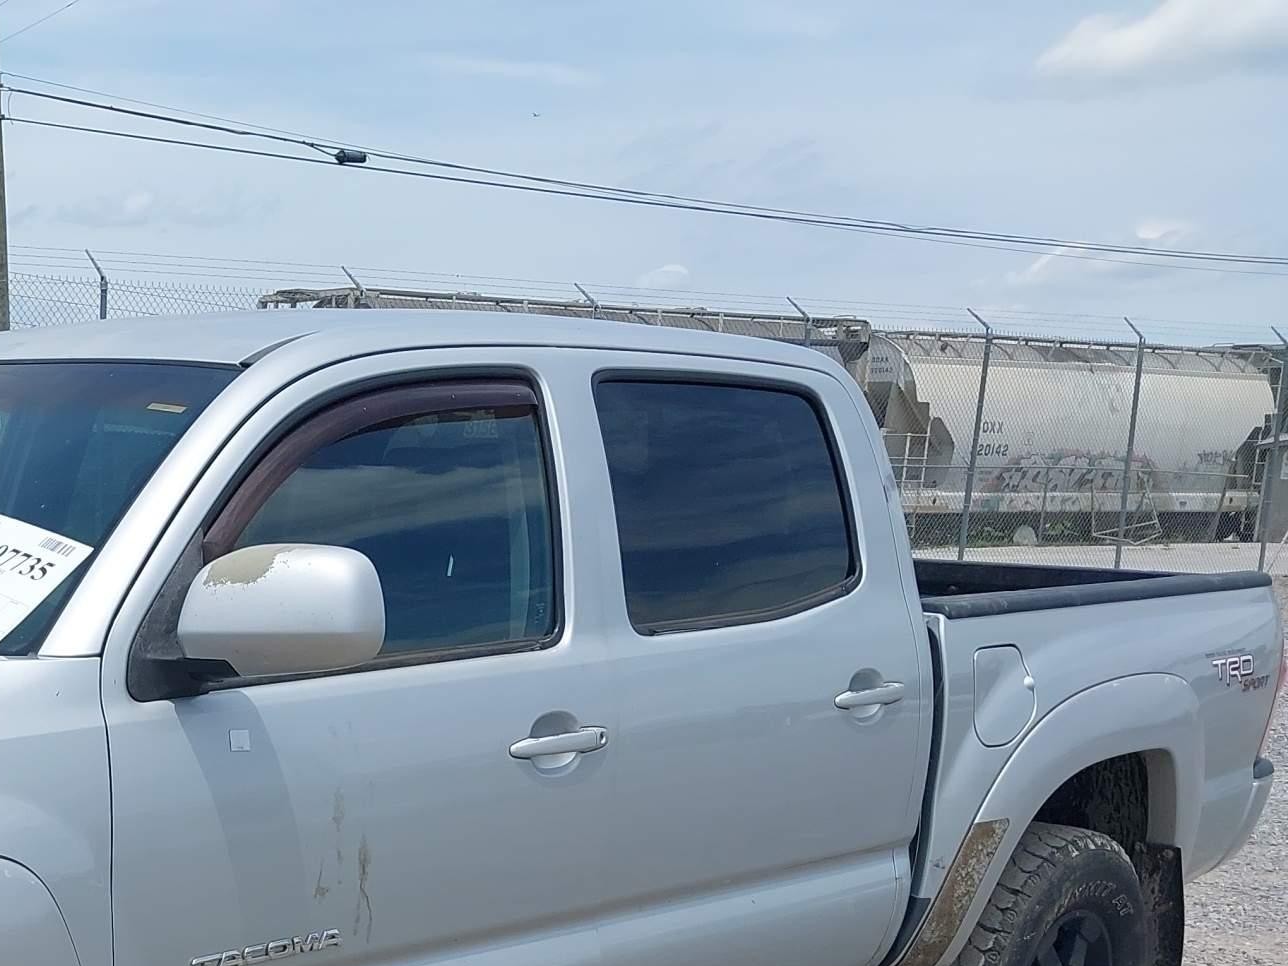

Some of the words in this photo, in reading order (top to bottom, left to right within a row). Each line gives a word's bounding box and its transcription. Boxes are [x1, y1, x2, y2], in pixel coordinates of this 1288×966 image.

[976, 443, 1009, 457] 20142
[1212, 653, 1254, 687] TRD
[1241, 674, 1270, 692] SPORT
